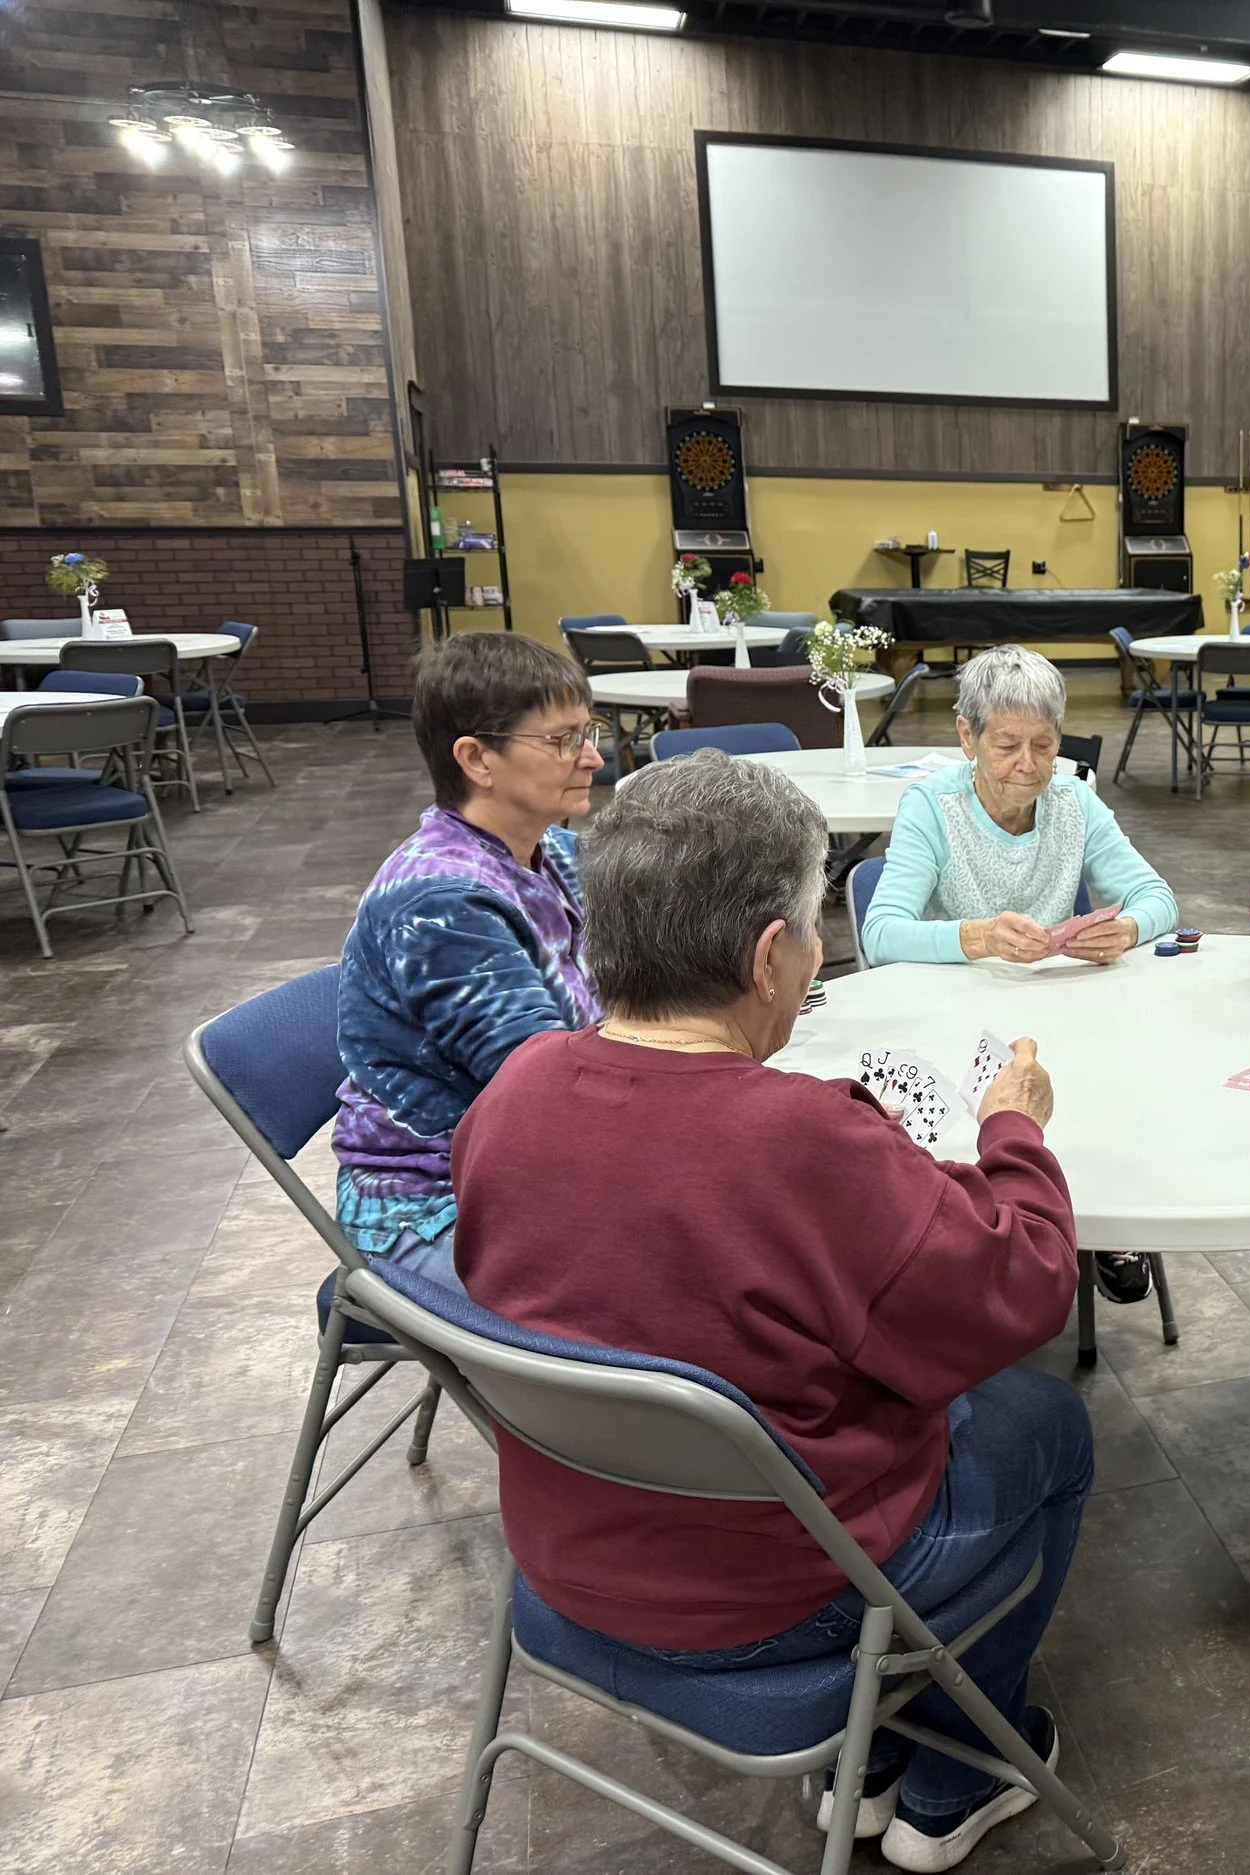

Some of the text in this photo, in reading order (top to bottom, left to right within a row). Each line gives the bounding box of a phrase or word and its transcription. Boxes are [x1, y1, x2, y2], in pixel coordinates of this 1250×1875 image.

[860, 1052, 874, 1069] Q
[877, 1051, 891, 1065] J
[905, 1065, 918, 1080] 9
[923, 1075, 936, 1089] 7
